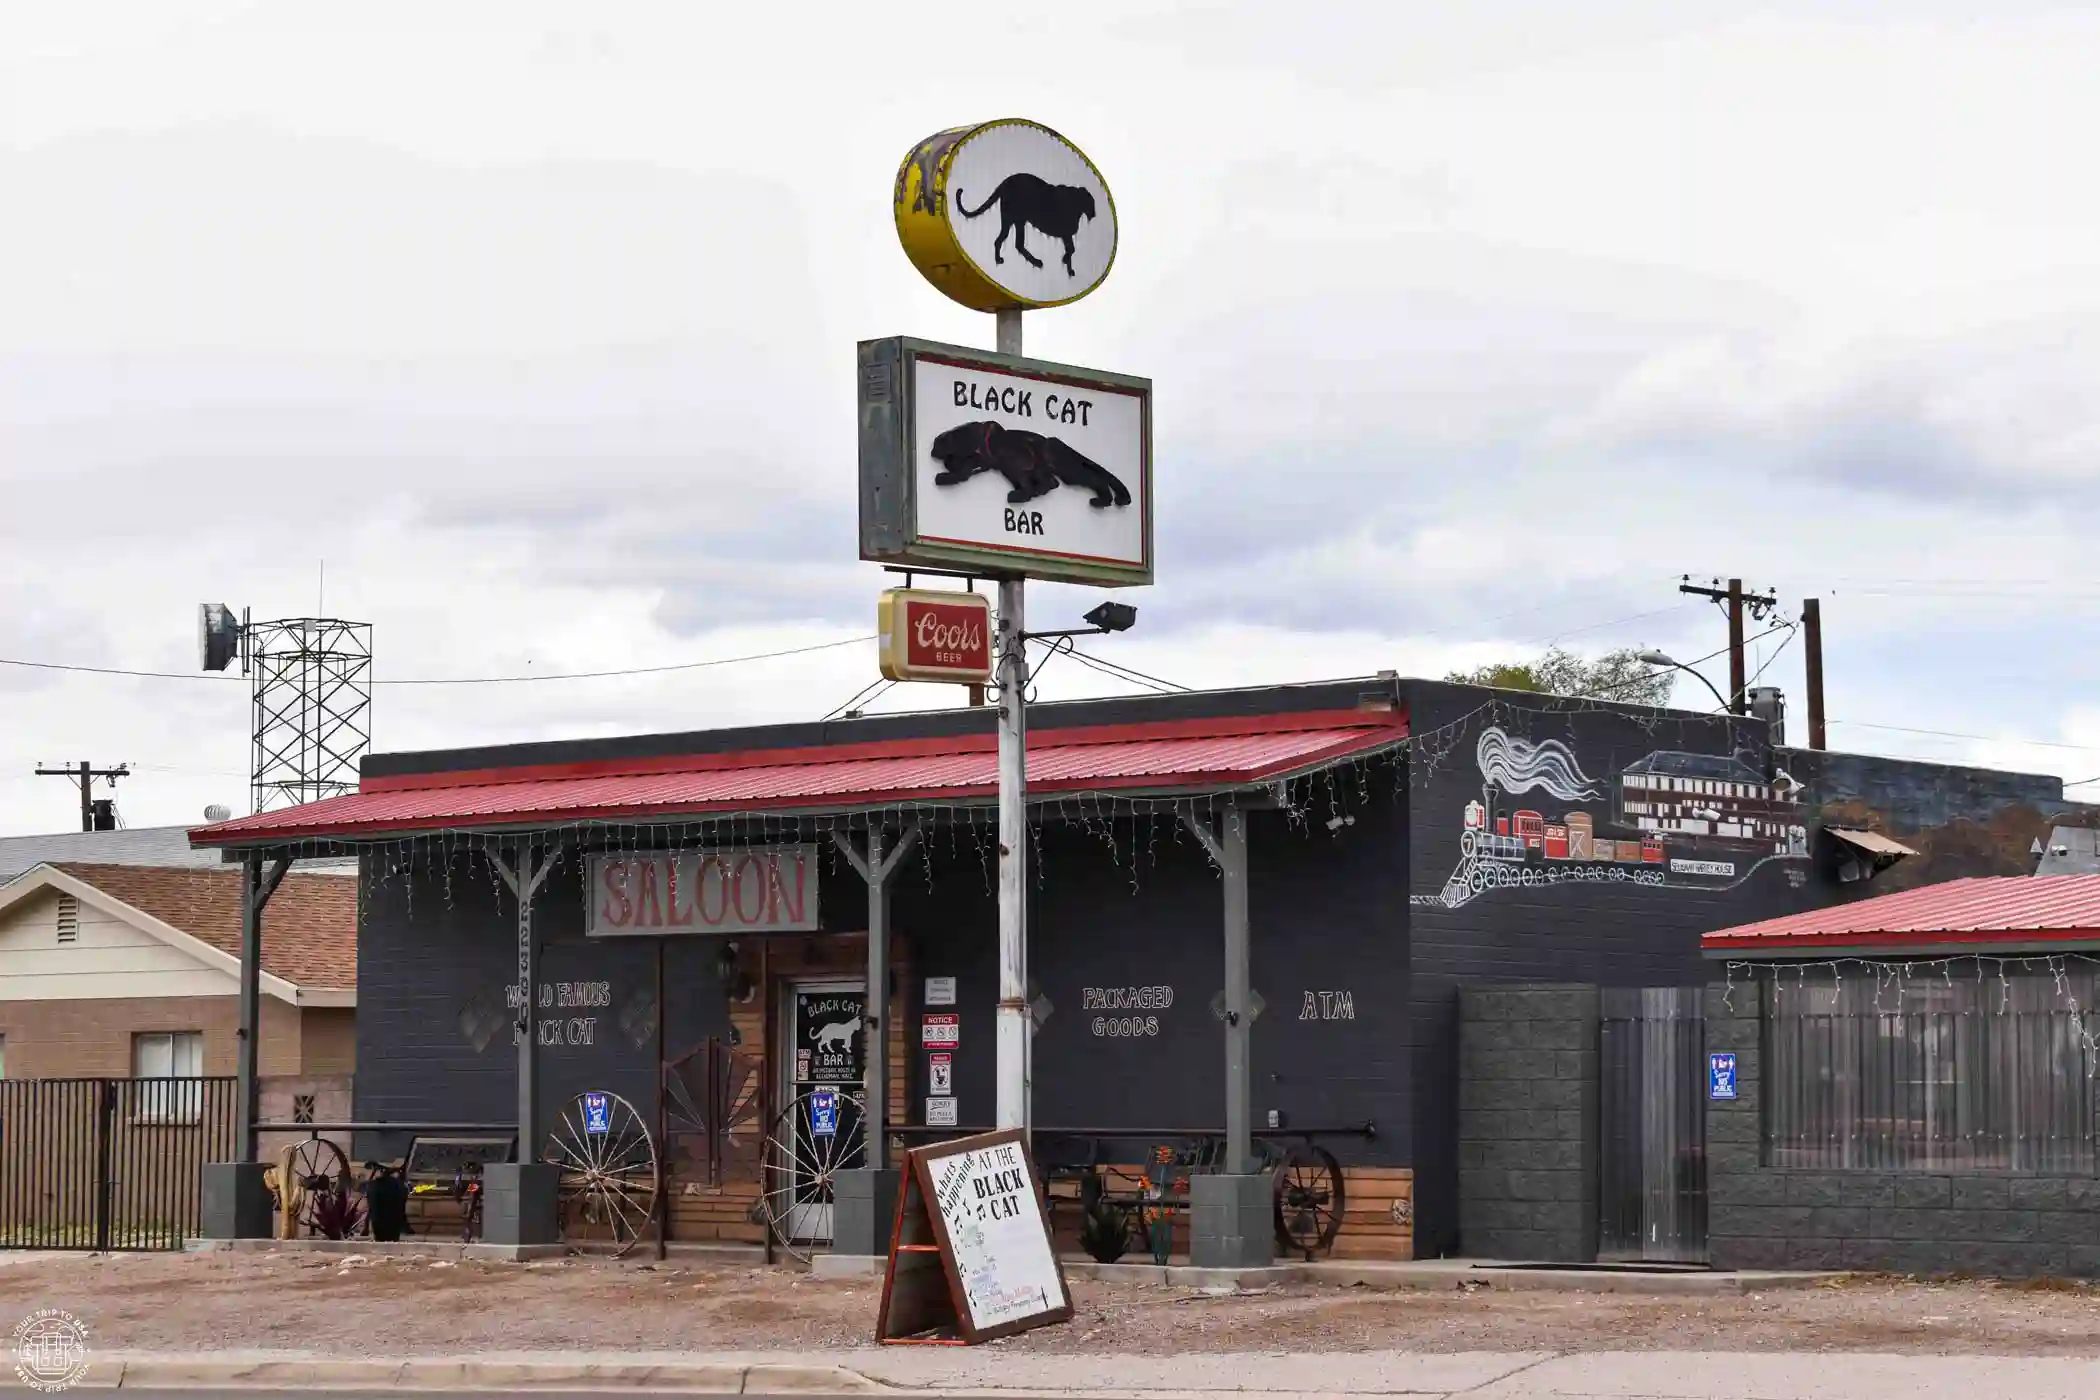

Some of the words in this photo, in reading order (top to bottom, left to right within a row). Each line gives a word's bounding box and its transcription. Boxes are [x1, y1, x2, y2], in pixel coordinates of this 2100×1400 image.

[954, 380, 1033, 418] BLACK
[1046, 393, 1093, 426] CAT
[1004, 507, 1045, 536] BAR
[914, 612, 981, 652] Coors
[936, 651, 962, 663] BEER
[602, 854, 806, 928] SALOON
[556, 980, 611, 1007] FAMOUS
[1082, 985, 1174, 1009] PACKAGED
[1298, 989, 1356, 1020] ATM
[807, 999, 839, 1018] BLACK
[841, 999, 863, 1015] CAT
[928, 1016, 953, 1025] NOTICE
[566, 1017, 597, 1045] CAT
[1091, 1016, 1160, 1037] GOODS
[823, 1053, 844, 1066] BAR
[978, 1151, 992, 1172] AT
[995, 1146, 1017, 1167] THE
[940, 1151, 976, 1218] happening
[973, 1167, 1025, 1199] BLACK
[990, 1195, 1021, 1221] CAT
